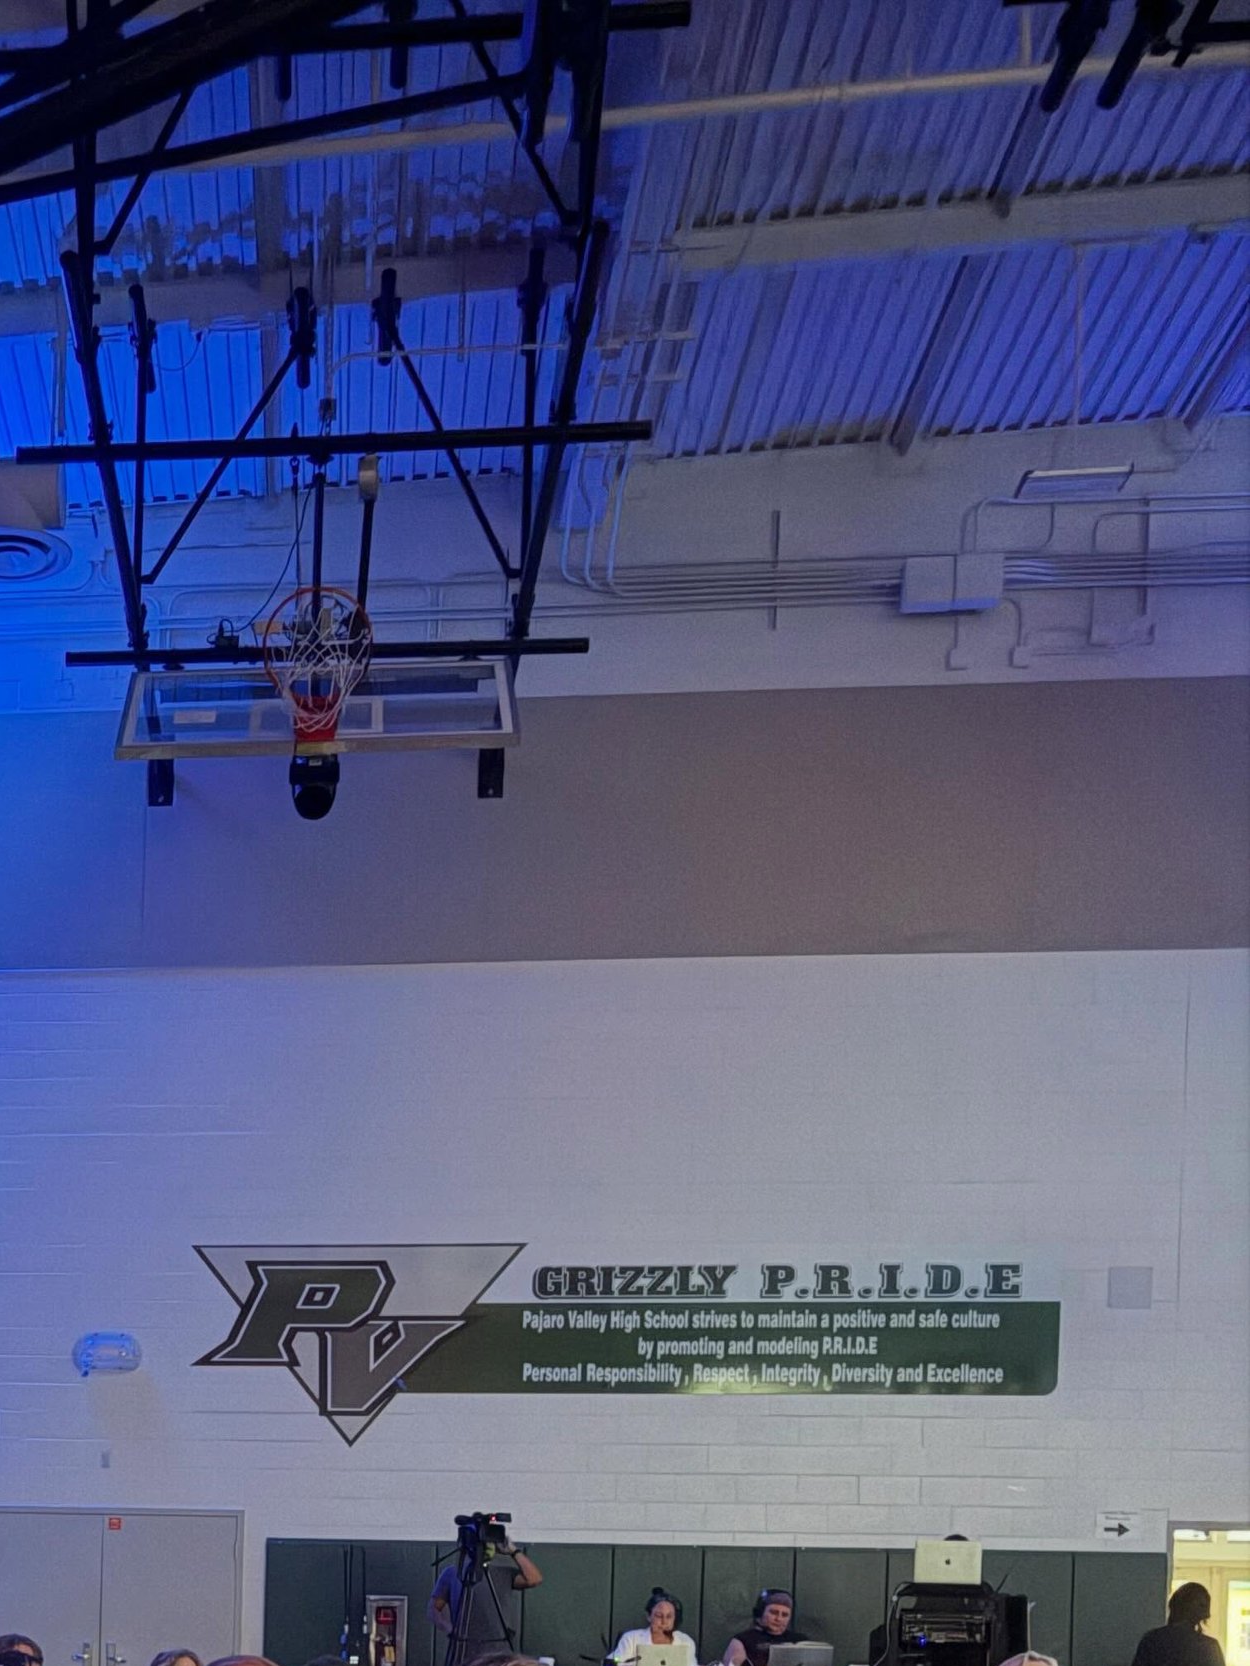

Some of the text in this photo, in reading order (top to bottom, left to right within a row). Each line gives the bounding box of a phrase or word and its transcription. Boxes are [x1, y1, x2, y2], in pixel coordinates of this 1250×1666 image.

[532, 1263, 1023, 1300] GRIZZLY P.R.I.D.E
[522, 1309, 1000, 1333] Pajaro Valley High School strives to maintain a positive and safe culture
[638, 1336, 878, 1359] by promoting and modeling P.R.I.D.E
[522, 1363, 582, 1382] Personal
[831, 1363, 893, 1387] Diversity
[896, 1363, 923, 1382] and
[926, 1363, 1004, 1383] Excellence
